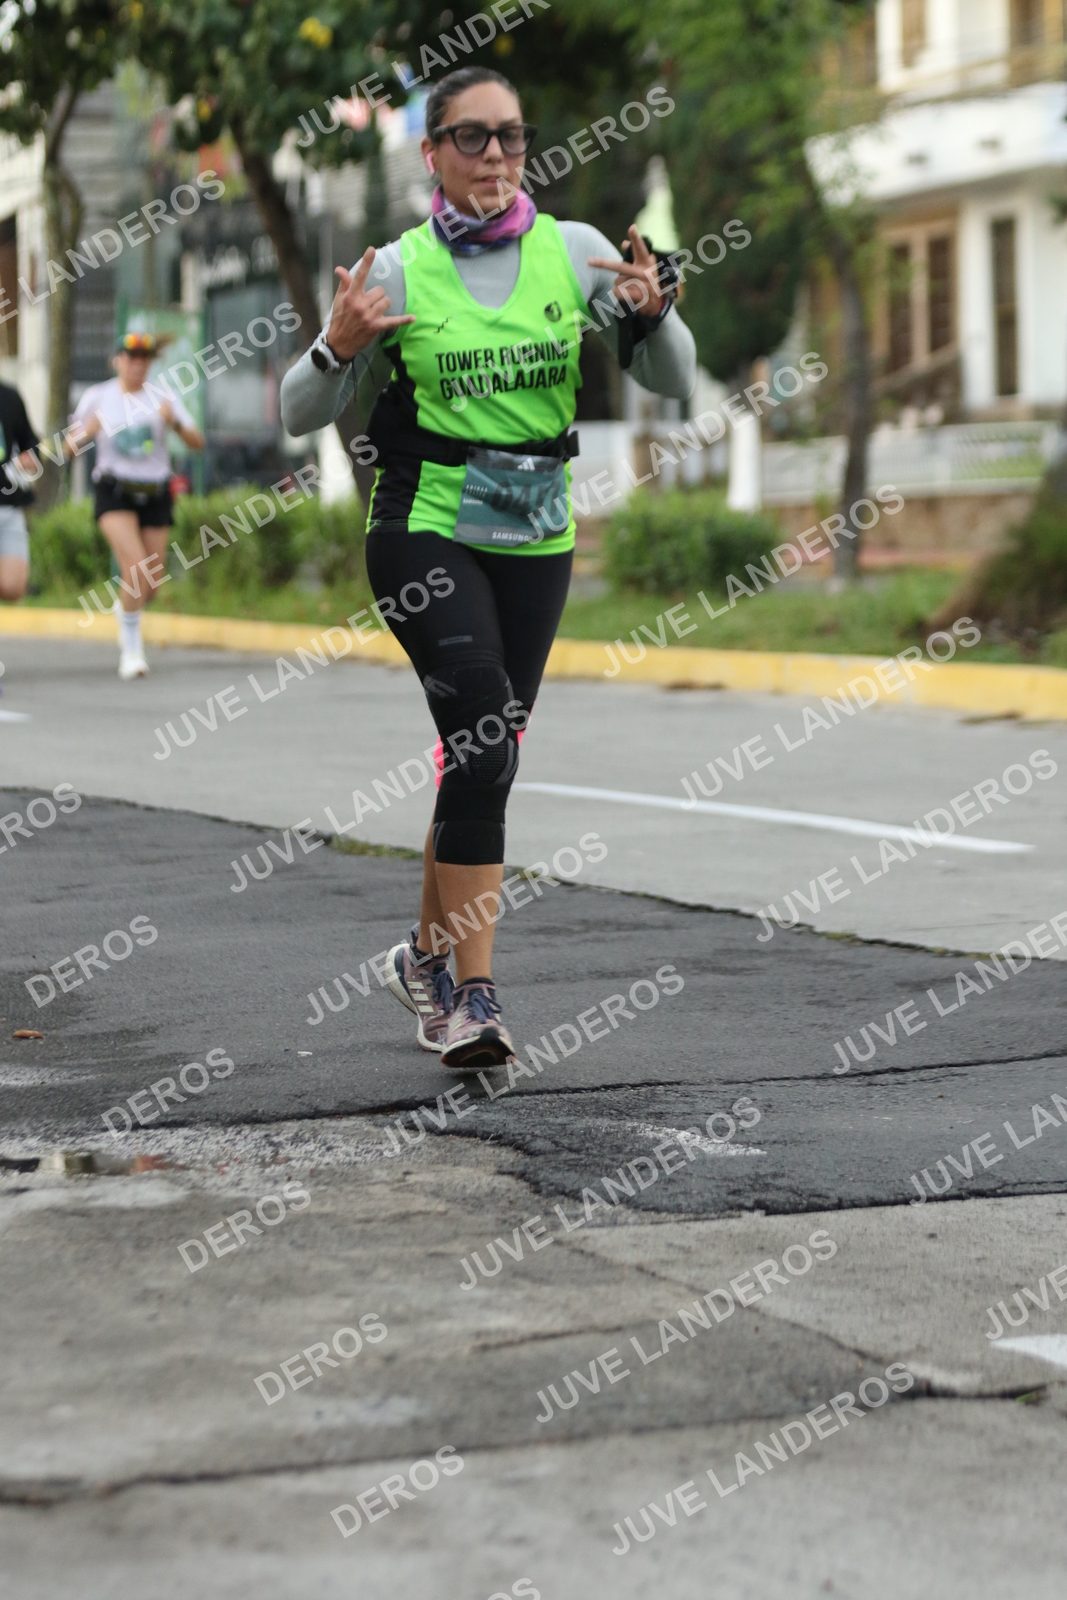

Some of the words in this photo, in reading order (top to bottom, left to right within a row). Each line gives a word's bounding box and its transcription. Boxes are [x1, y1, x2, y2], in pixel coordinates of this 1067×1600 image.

[435, 347, 495, 374] TOWER
[499, 338, 570, 366] RUNNING
[440, 364, 567, 401] GUADALAJARA
[491, 531, 530, 542] SAMSUNG
